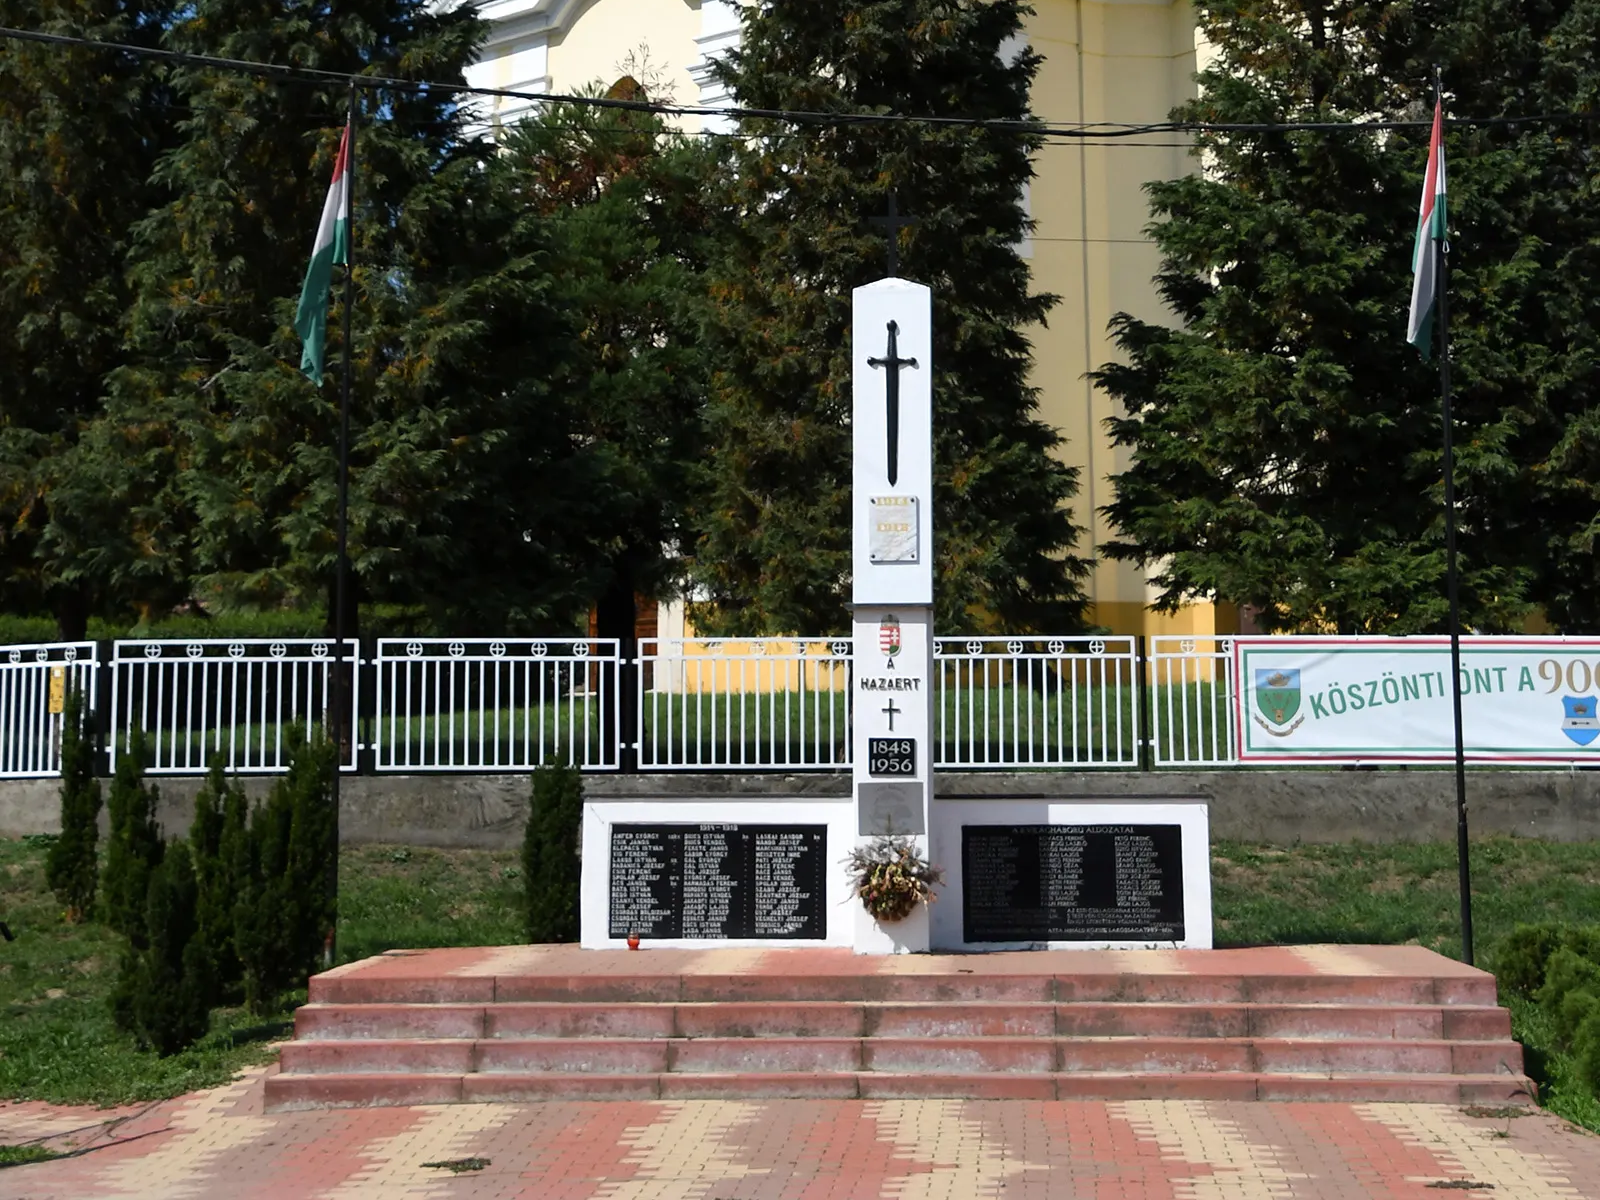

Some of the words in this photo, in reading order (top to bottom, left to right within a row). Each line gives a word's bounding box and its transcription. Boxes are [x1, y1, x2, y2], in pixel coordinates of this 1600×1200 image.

[887, 657, 895, 670] A
[1309, 671, 1445, 720] KÖSZÖNTI
[1518, 666, 1535, 692] A
[1538, 658, 1600, 695] 90
[872, 740, 911, 754] 1848
[871, 758, 913, 772] 1956
